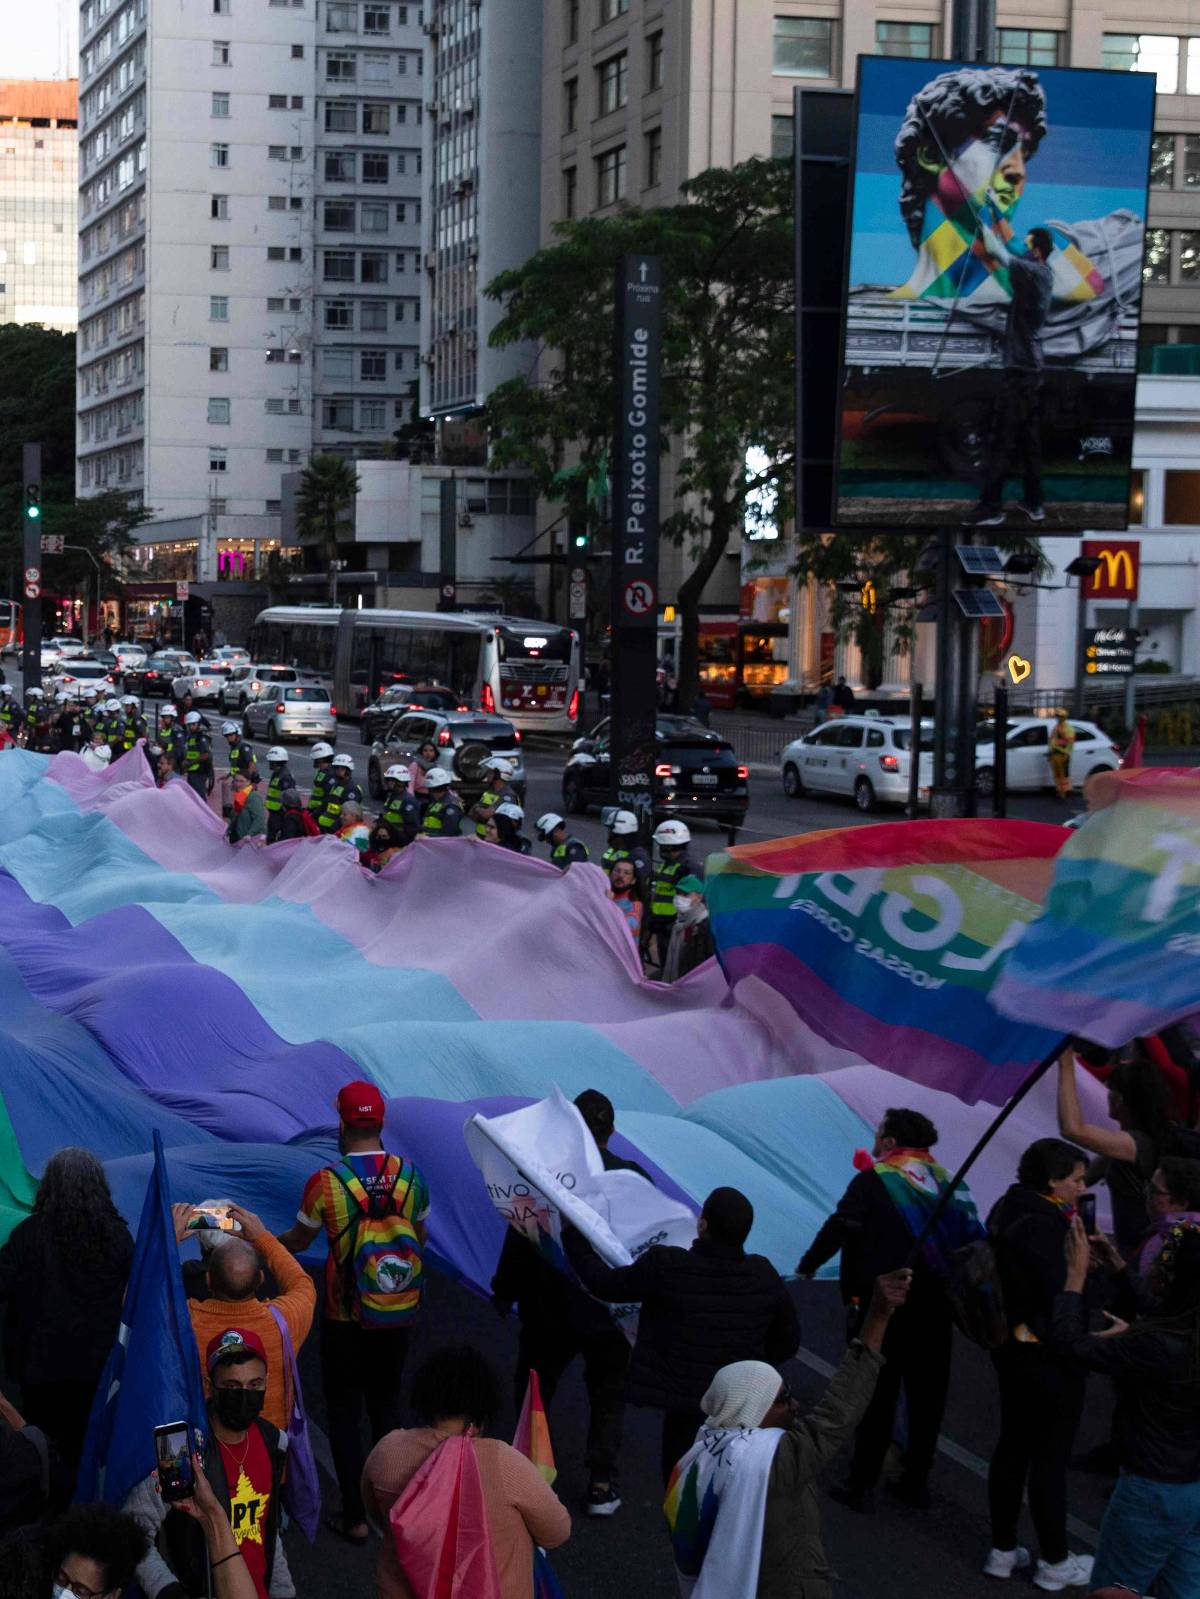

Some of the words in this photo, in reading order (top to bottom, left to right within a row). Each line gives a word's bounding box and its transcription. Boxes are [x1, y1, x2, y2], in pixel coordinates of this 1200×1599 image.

[628, 327, 649, 427] Gomide
[626, 433, 647, 533] Peixoto
[625, 541, 643, 564] R.
[233, 1498, 261, 1530] PT
